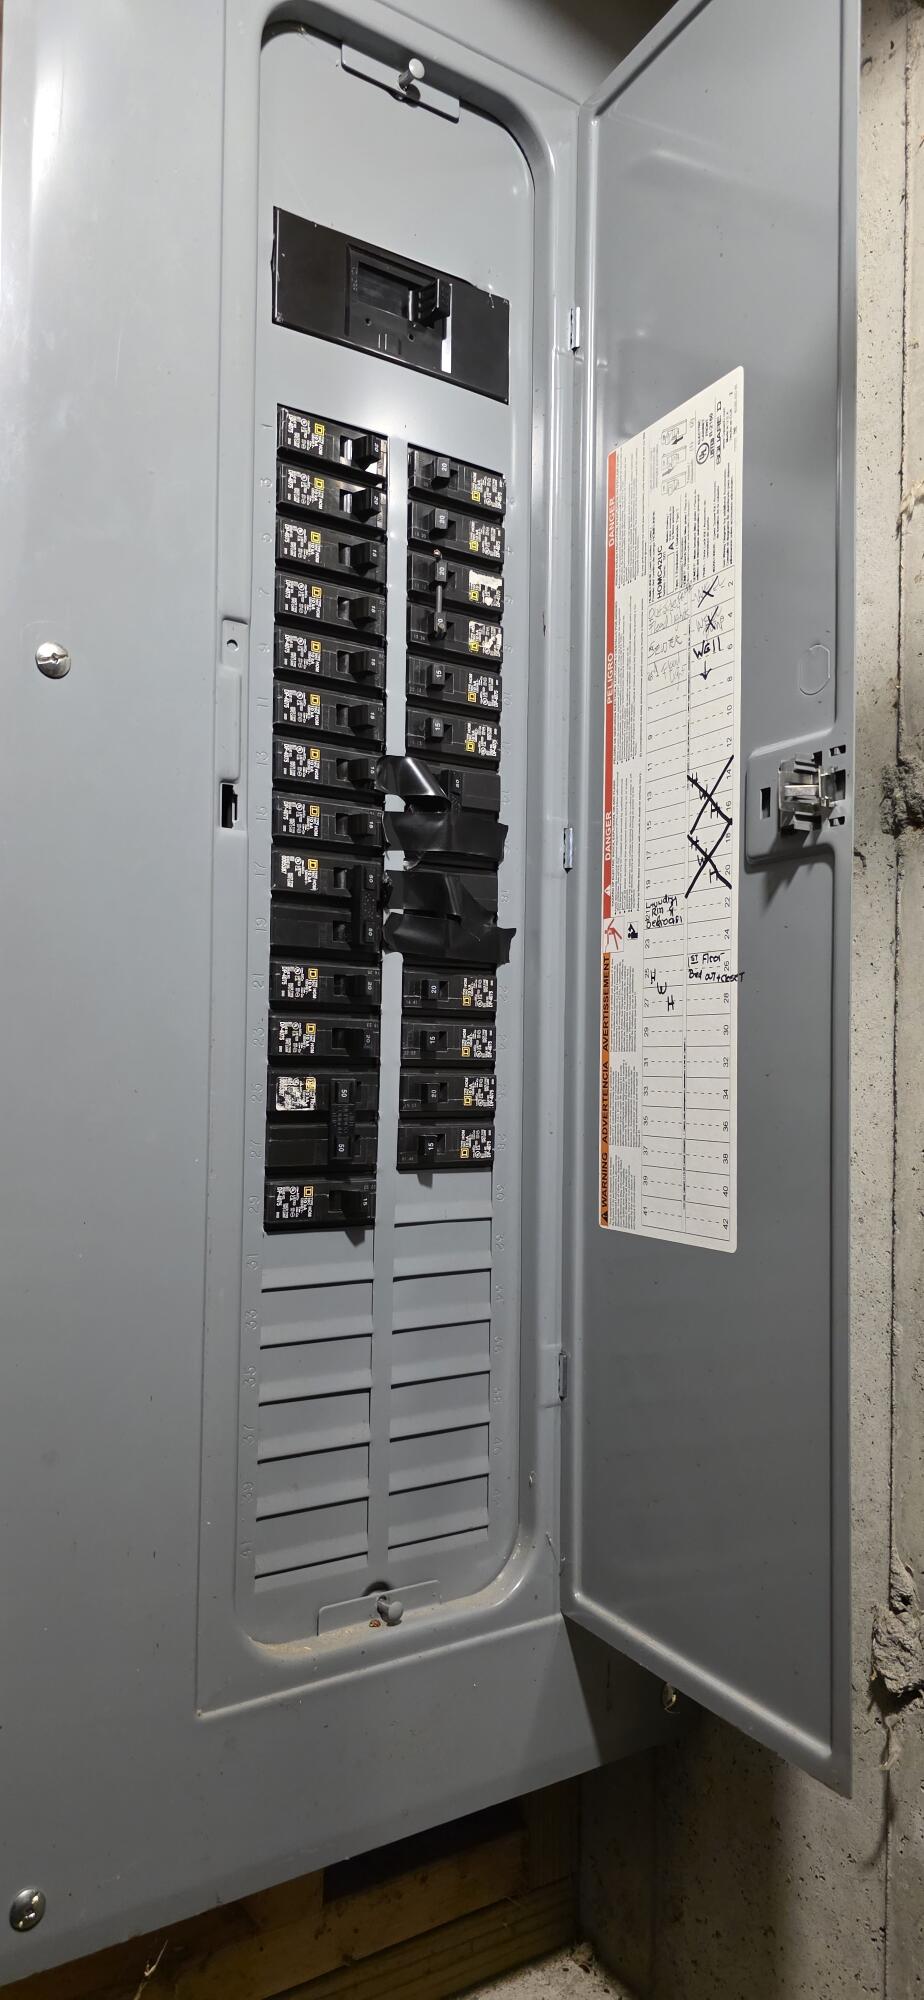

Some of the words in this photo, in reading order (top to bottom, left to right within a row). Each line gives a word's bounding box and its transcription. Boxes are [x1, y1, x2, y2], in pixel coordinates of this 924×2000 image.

[717, 401, 721, 412] D
[606, 653, 614, 704] PELIGRO
[726, 705, 732, 715] 10
[726, 737, 732, 747] 12
[726, 769, 732, 779] 14
[726, 800, 731, 811] 16
[726, 833, 731, 843] 18
[725, 864, 731, 875] 20
[725, 896, 730, 907] 22
[724, 928, 730, 939] 24
[724, 960, 729, 971] 26
[667, 995, 675, 1012] H
[723, 993, 729, 1003] 28
[723, 1024, 728, 1036] 30
[723, 1057, 728, 1068] 32
[723, 1089, 728, 1100] 34
[723, 1121, 728, 1132] 36
[723, 1153, 728, 1164] 38
[723, 1186, 728, 1197] 40
[723, 1218, 728, 1230] 42
